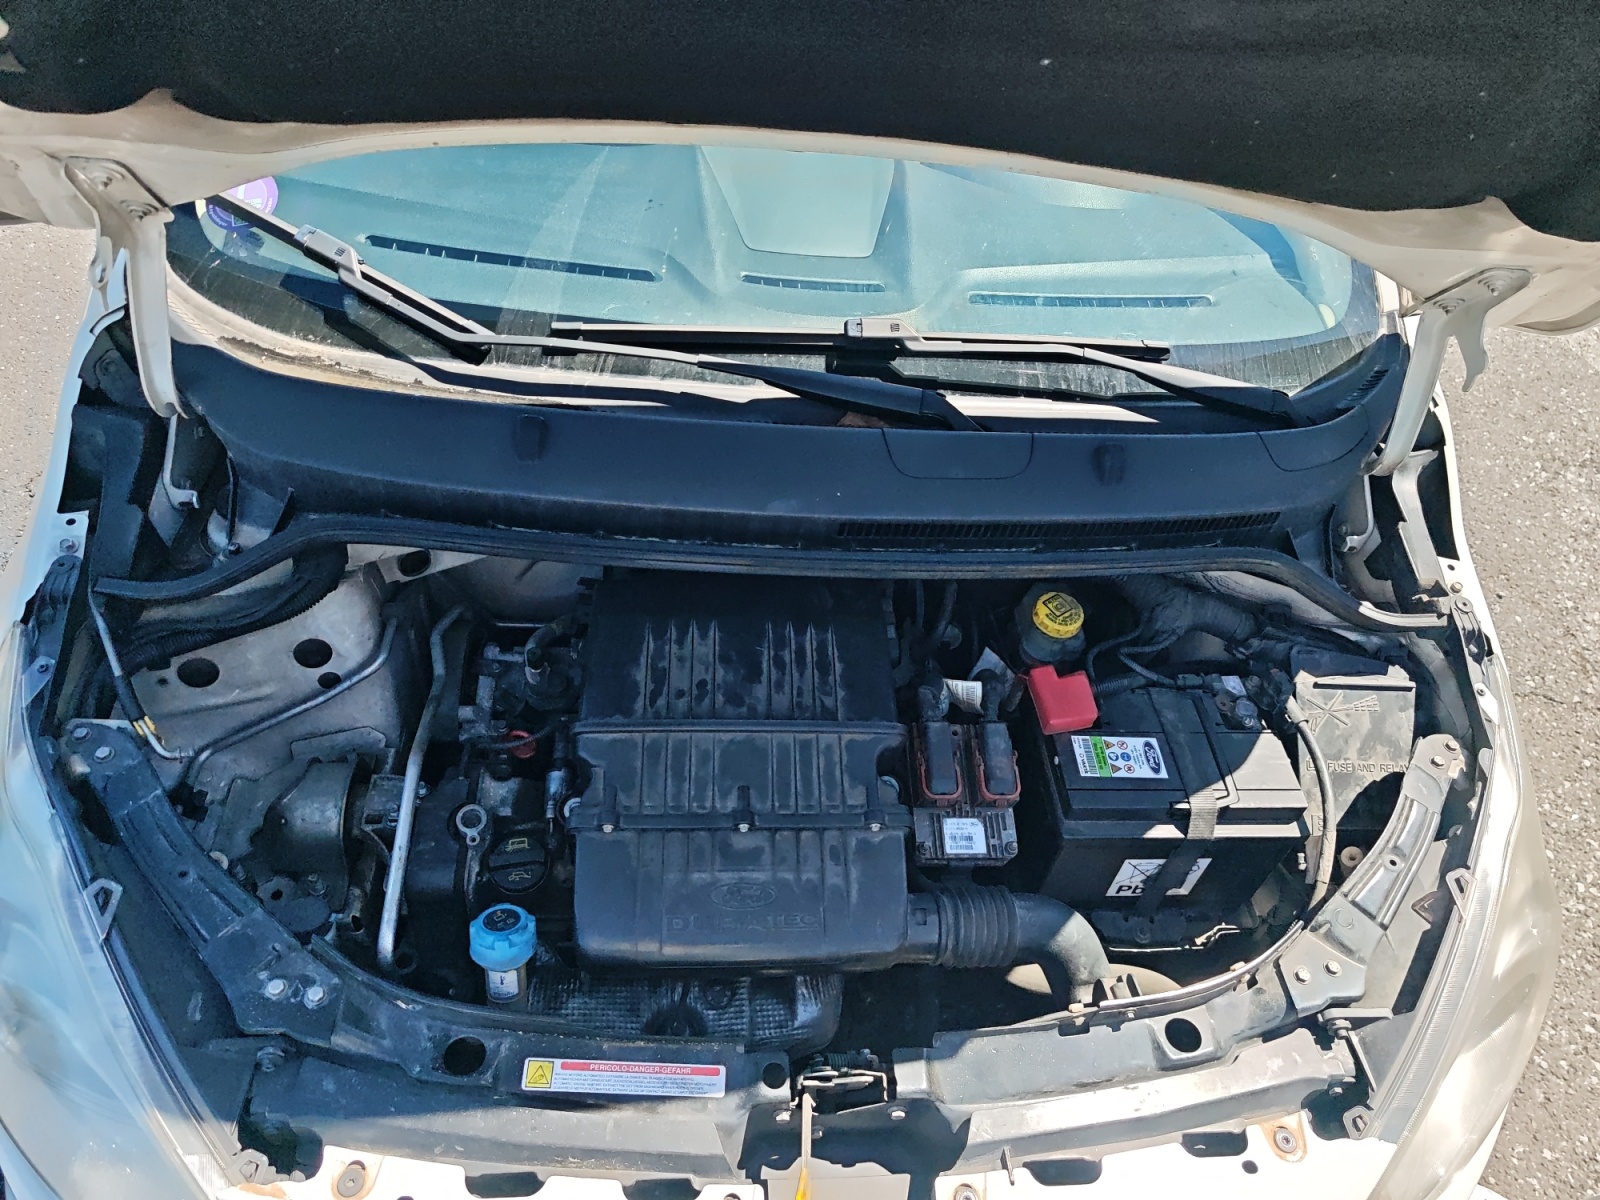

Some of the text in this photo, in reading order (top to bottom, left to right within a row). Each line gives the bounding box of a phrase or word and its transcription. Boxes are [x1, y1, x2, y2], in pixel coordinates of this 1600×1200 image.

[1145, 746, 1159, 769] Ford
[1327, 762, 1352, 773] FUSE
[1356, 762, 1375, 773] AND
[1115, 885, 1145, 894] Pb
[590, 1063, 691, 1074] PERICOLO-DANGER-GEFAHR
